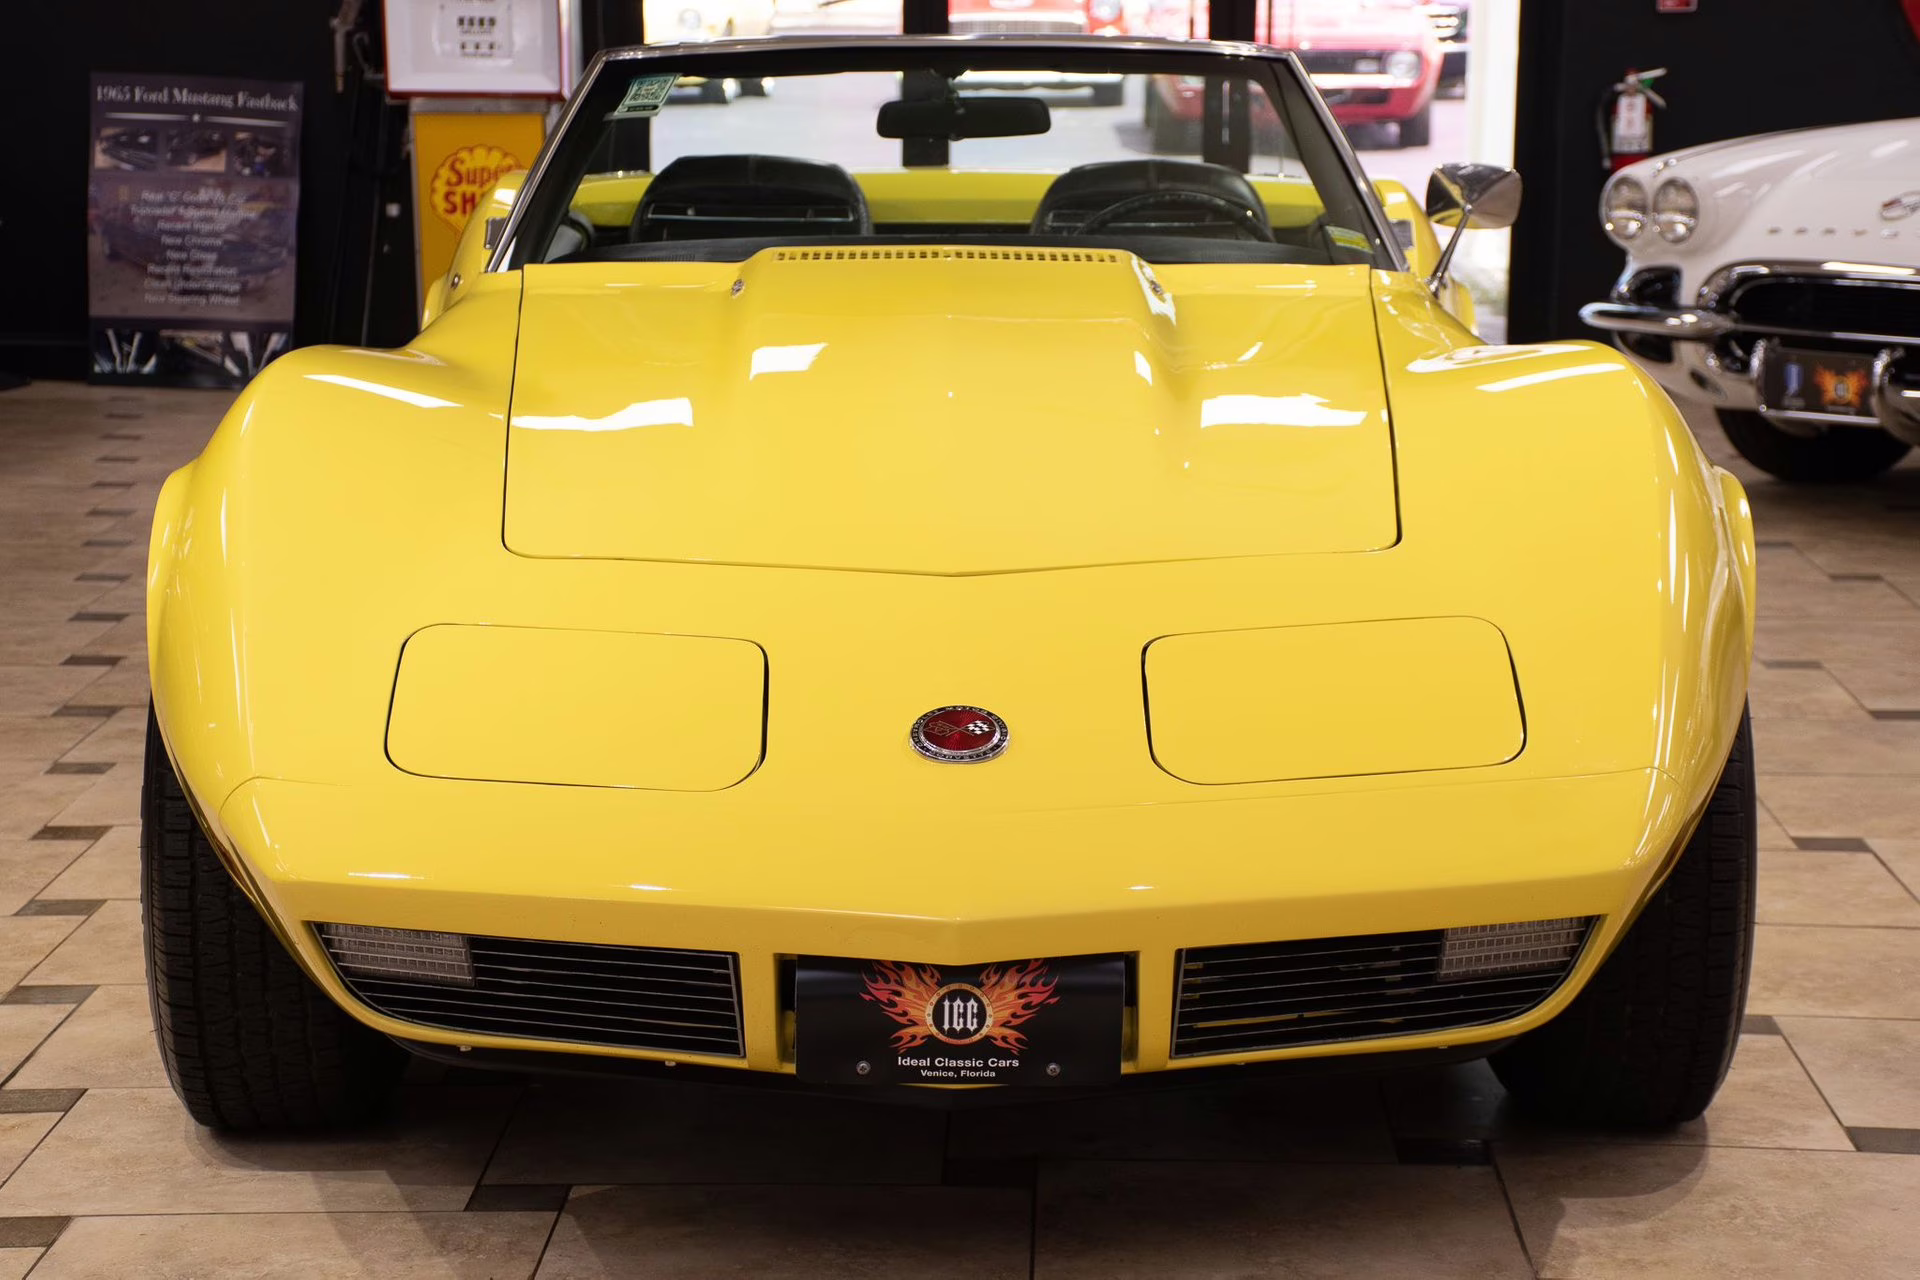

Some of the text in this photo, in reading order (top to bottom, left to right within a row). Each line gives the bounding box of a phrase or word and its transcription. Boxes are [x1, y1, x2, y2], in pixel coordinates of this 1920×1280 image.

[97, 86, 299, 112] 1965 Ford Mustang Fastback
[898, 1056, 1019, 1068] Ideal Classic Cars
[920, 1069, 996, 1078] Venice, Florida
